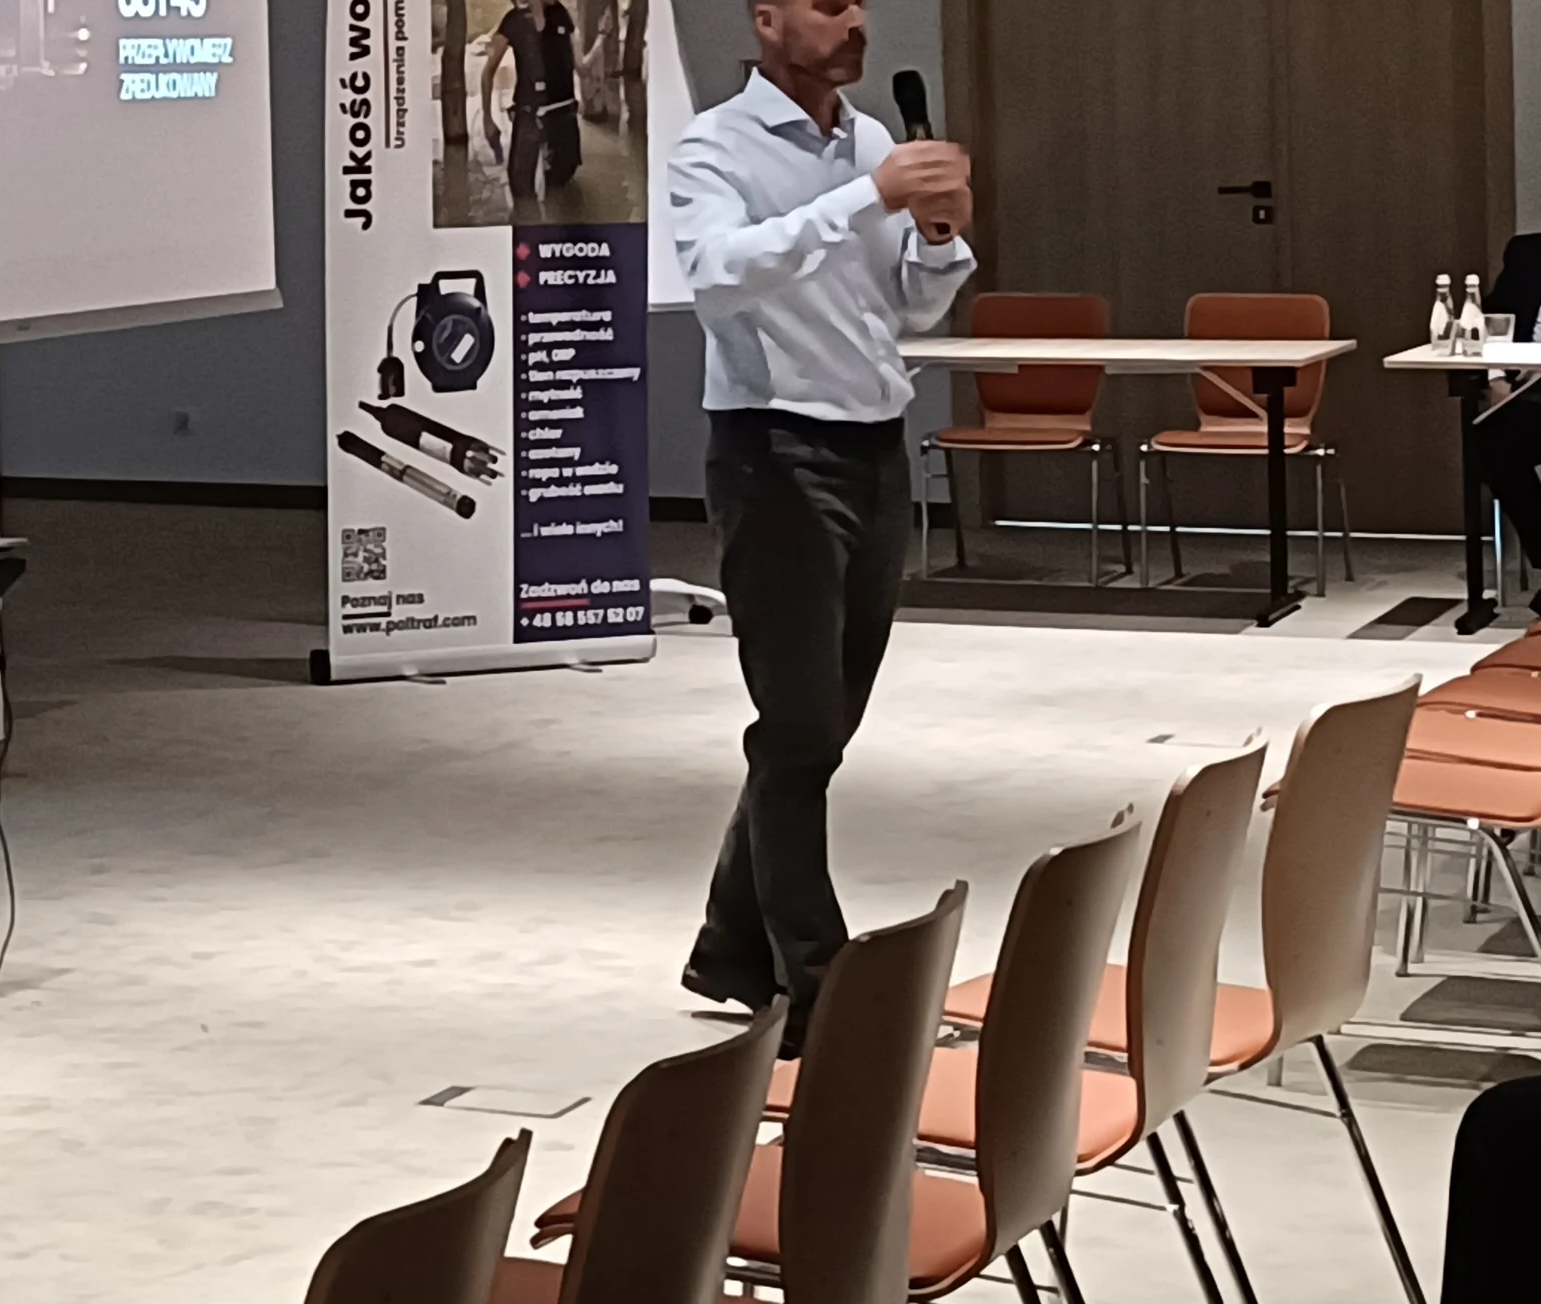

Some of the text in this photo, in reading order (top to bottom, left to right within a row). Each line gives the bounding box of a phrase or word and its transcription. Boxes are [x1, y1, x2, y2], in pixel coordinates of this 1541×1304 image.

[392, 45, 409, 149] Urządzenia
[339, 70, 373, 231] Jakość
[538, 242, 611, 258] WYGODA
[538, 269, 617, 285] PRECYZJA
[519, 579, 641, 598] Zadzwoń do nas
[341, 590, 425, 611] Poznaj nas
[341, 614, 477, 636] www.poltraf.com
[532, 612, 552, 627] 48
[626, 606, 645, 622] 07
